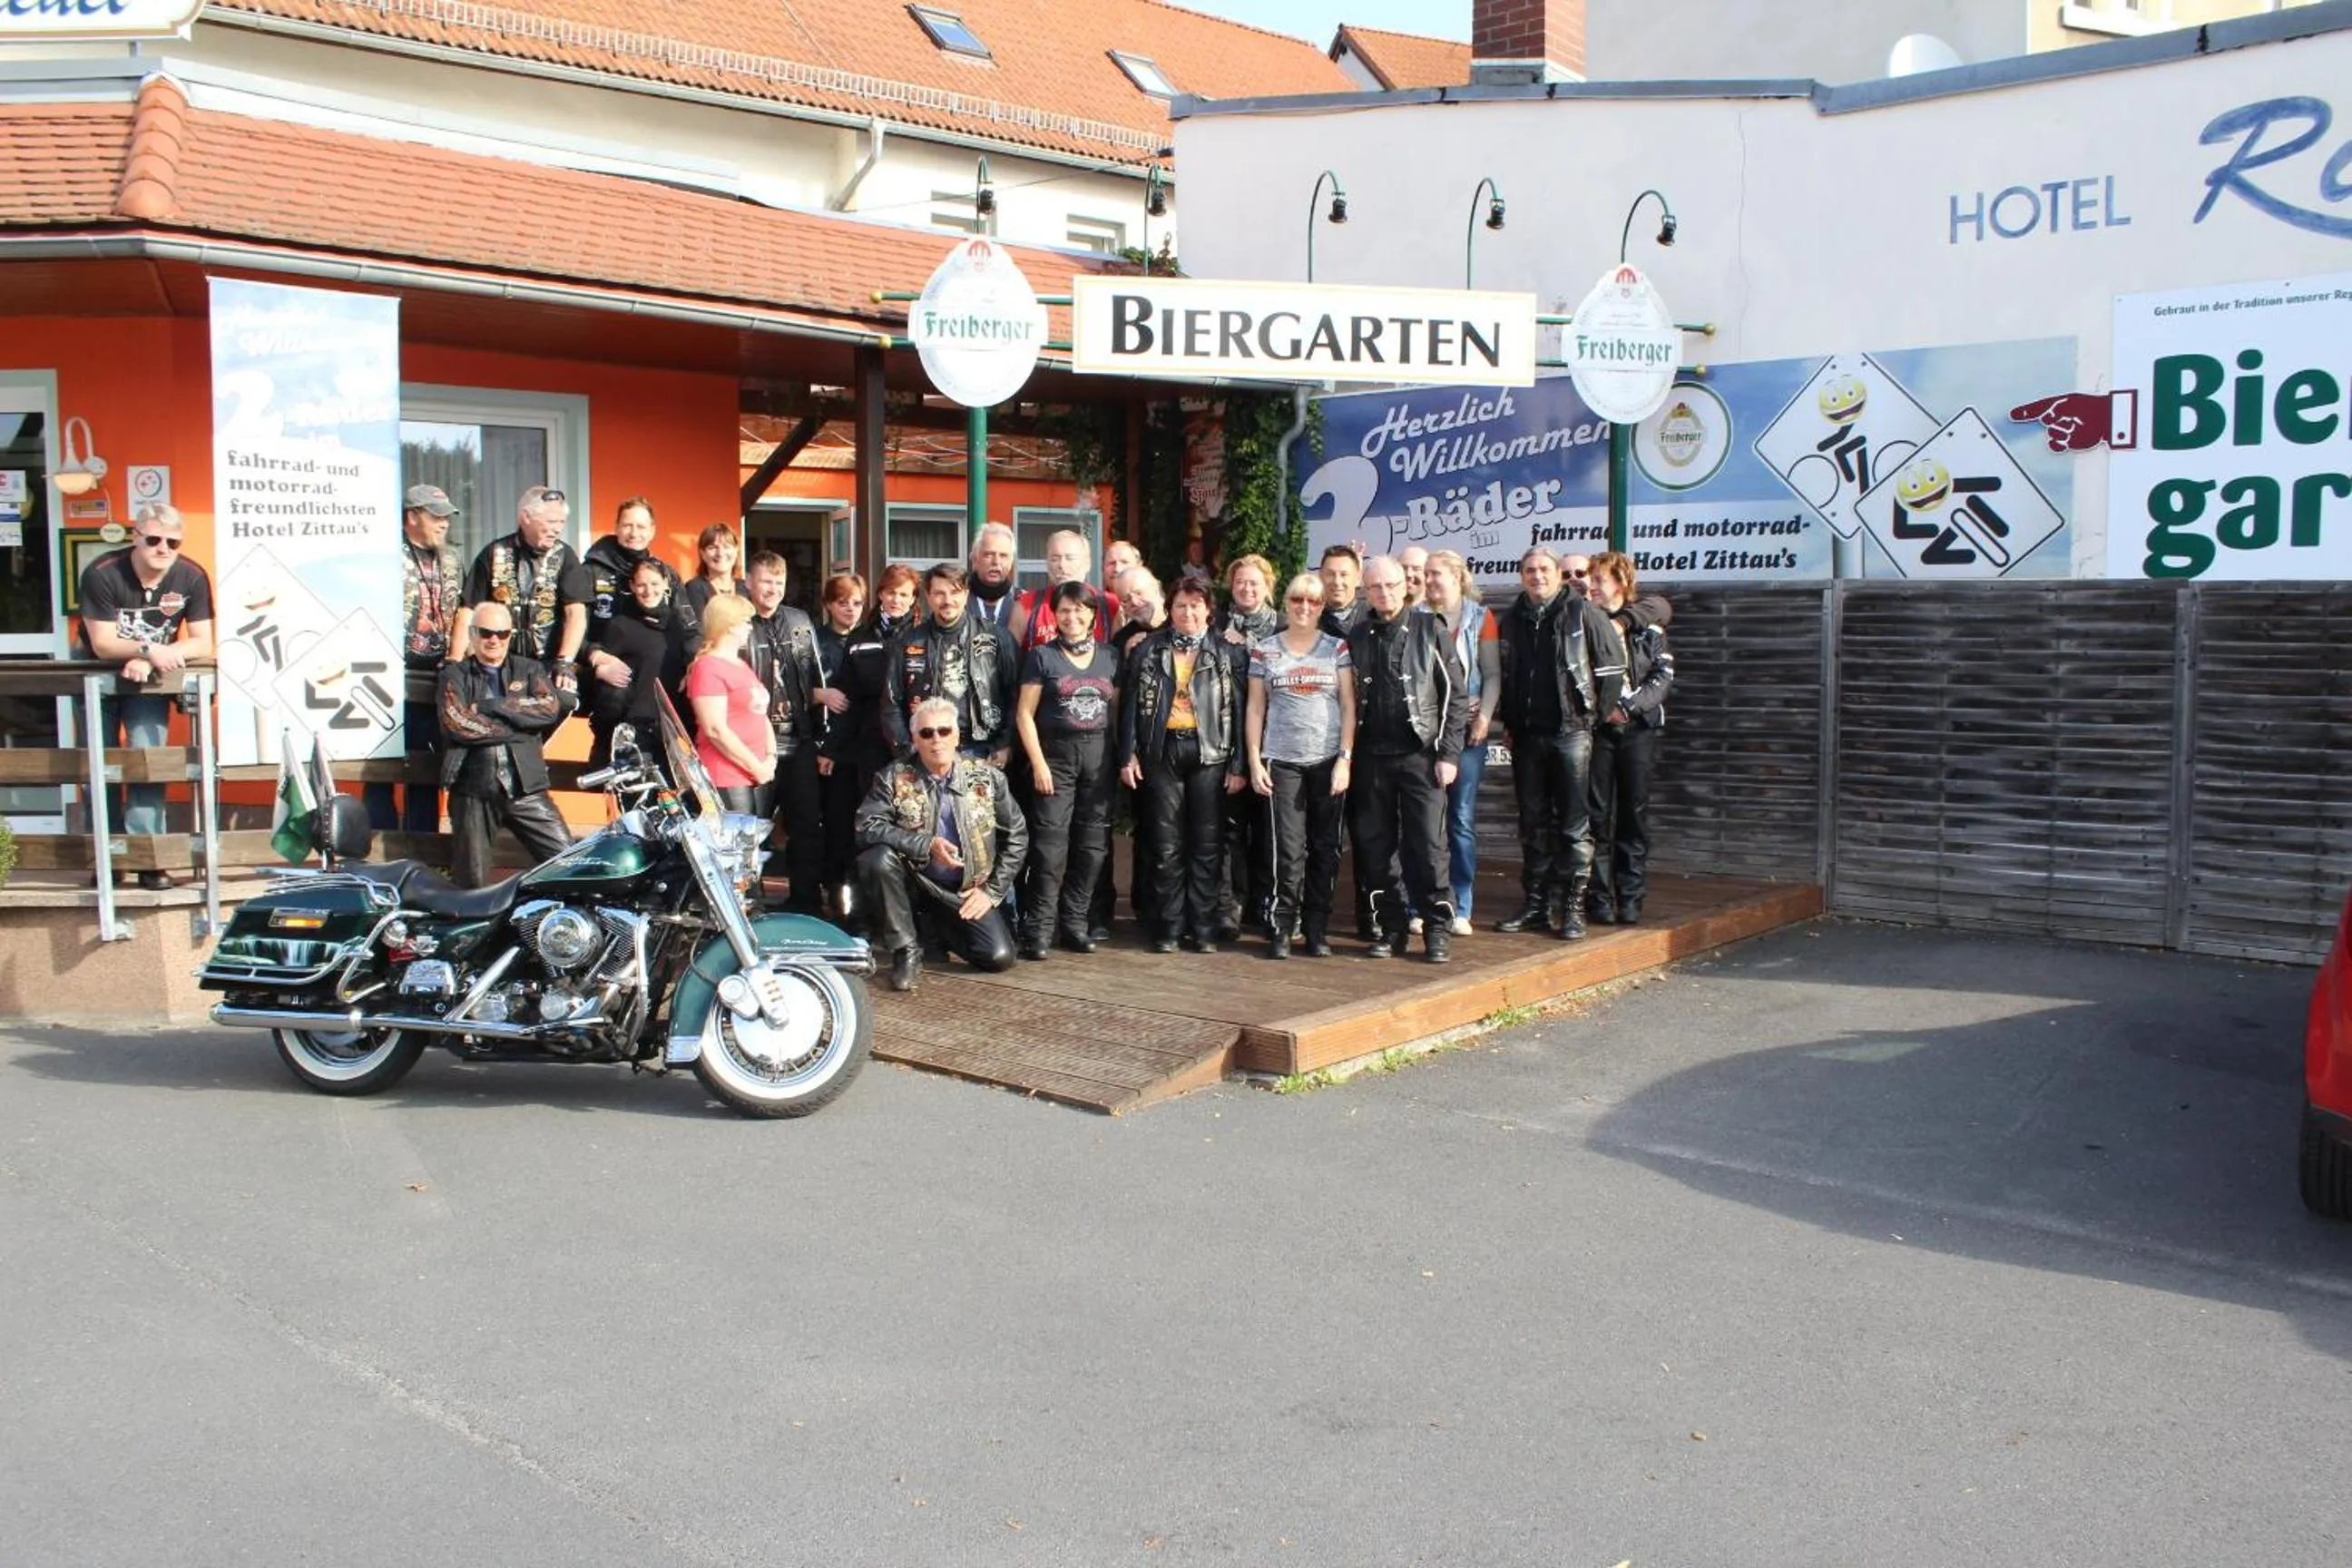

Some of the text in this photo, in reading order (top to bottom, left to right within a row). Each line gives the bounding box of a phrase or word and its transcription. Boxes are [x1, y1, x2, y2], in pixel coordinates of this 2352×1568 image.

[1950, 175, 2132, 244] HOTEL
[2154, 305, 2196, 317] Gebraut
[2200, 302, 2210, 312] in
[2212, 300, 2230, 312] der
[2234, 296, 2283, 309] Tradition
[2286, 293, 2329, 304] unserer
[924, 311, 1034, 346] Freiberger
[1112, 294, 1501, 368] BIERGARTEN
[1576, 335, 1673, 366] Freiberger
[2151, 348, 2352, 451] Bie
[1360, 387, 1515, 459] Herzlich
[227, 449, 360, 477] fahrrad- und
[1389, 420, 1611, 483] Willkommen
[229, 478, 338, 495] motorrad-
[230, 497, 377, 515] freundlichsten
[232, 521, 369, 538] Hotel Zittau's
[1470, 531, 1501, 550] im
[1633, 518, 1677, 539] und
[1683, 514, 1811, 537] motorrad-
[1634, 550, 1697, 570] Hotel
[1704, 547, 1798, 570] Zittau's
